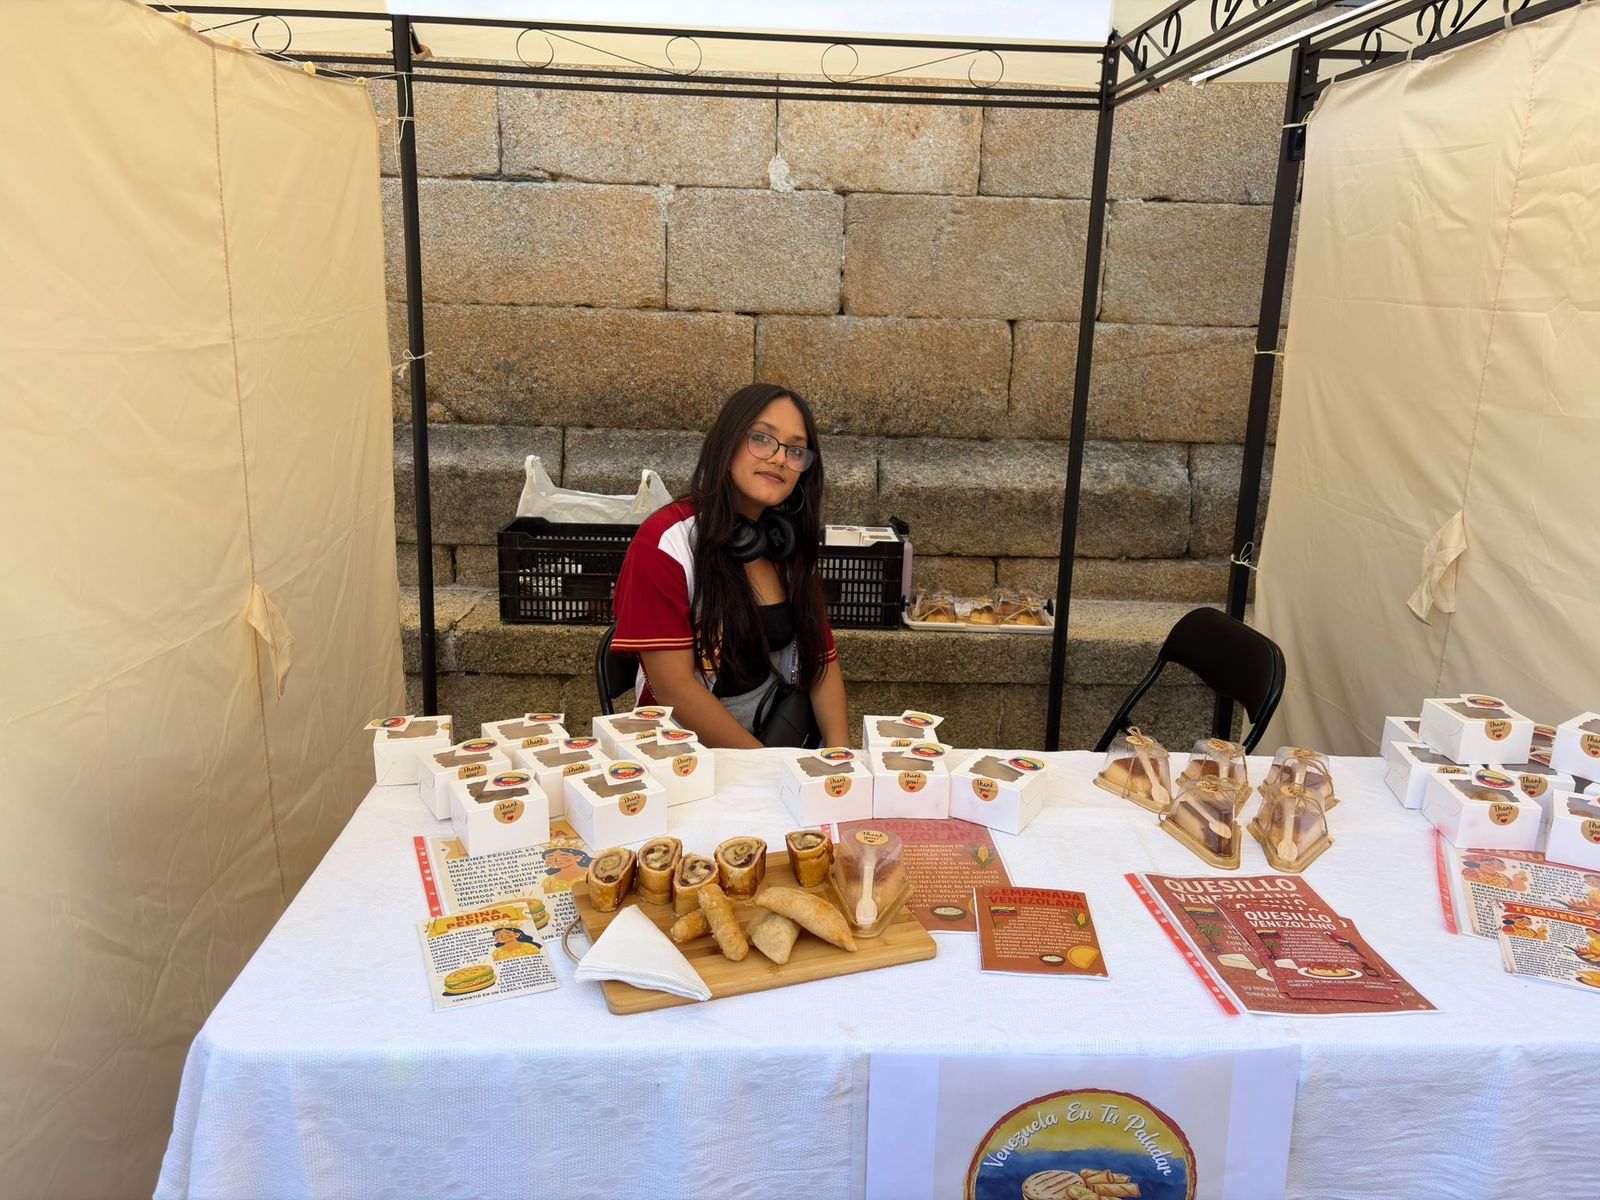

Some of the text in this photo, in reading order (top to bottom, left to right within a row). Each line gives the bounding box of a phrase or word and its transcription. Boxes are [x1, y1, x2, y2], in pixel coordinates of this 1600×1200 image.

[527, 738, 545, 747] Thank
[677, 757, 693, 765] Thank
[464, 765, 481, 773] Thank
[977, 780, 993, 788] Thank
[1522, 776, 1542, 784] Thank
[624, 795, 641, 804] Thank
[500, 801, 518, 810] Thank
[486, 849, 522, 858] PEPIADA
[466, 858, 492, 866] AREPA
[450, 870, 478, 878] HONOR
[488, 864, 519, 872] SUSANA
[463, 872, 498, 880] PRIMERA
[454, 880, 509, 892] CONSIDERADA
[1163, 879, 1298, 894] QUESILLO
[457, 892, 494, 902] HERMOSA
[1002, 889, 1081, 901] EMPANADA
[989, 897, 1085, 909] VENEZOLANA
[456, 909, 501, 921] REINA
[1244, 911, 1333, 923] QUESILLO
[447, 914, 511, 929] PEPIADA
[1249, 921, 1337, 931] VENEZOLANO
[983, 1102, 1173, 1177] Venezuela En Tu Paladar
